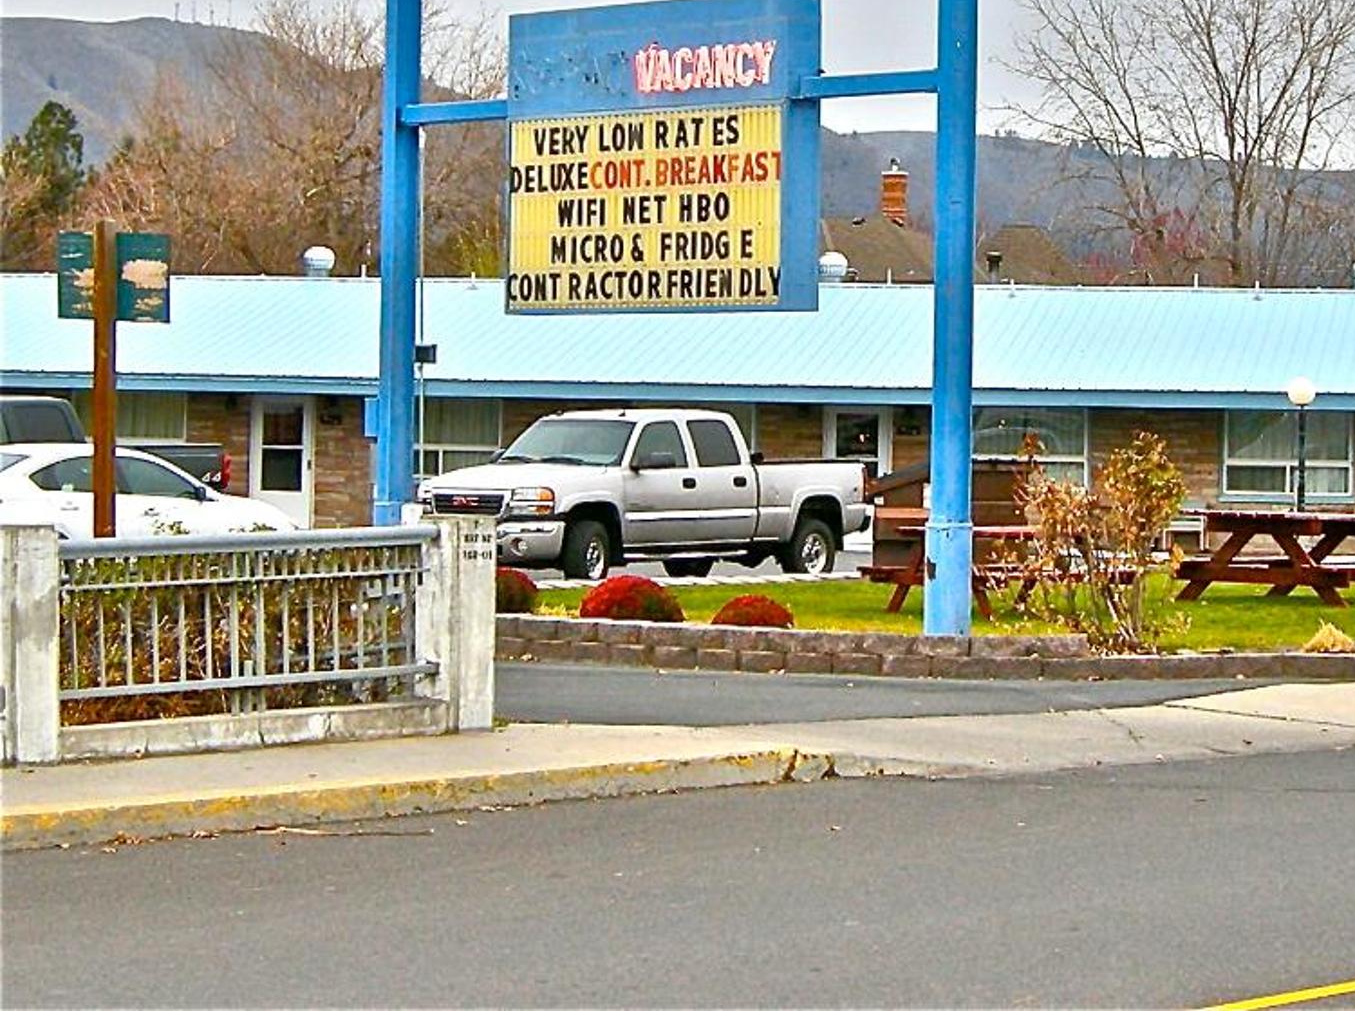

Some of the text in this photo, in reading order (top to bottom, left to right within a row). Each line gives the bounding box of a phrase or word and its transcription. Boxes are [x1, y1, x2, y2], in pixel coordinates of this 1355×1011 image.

[635, 39, 777, 93] VACANCY
[533, 124, 589, 157] VERY
[598, 120, 645, 152] LOW
[655, 150, 782, 188] BREAKFAST
[557, 192, 730, 228] WIFI NET HBO
[550, 234, 624, 265] MICRO
[630, 232, 645, 262] &
[665, 265, 782, 300] FRIENDLY
